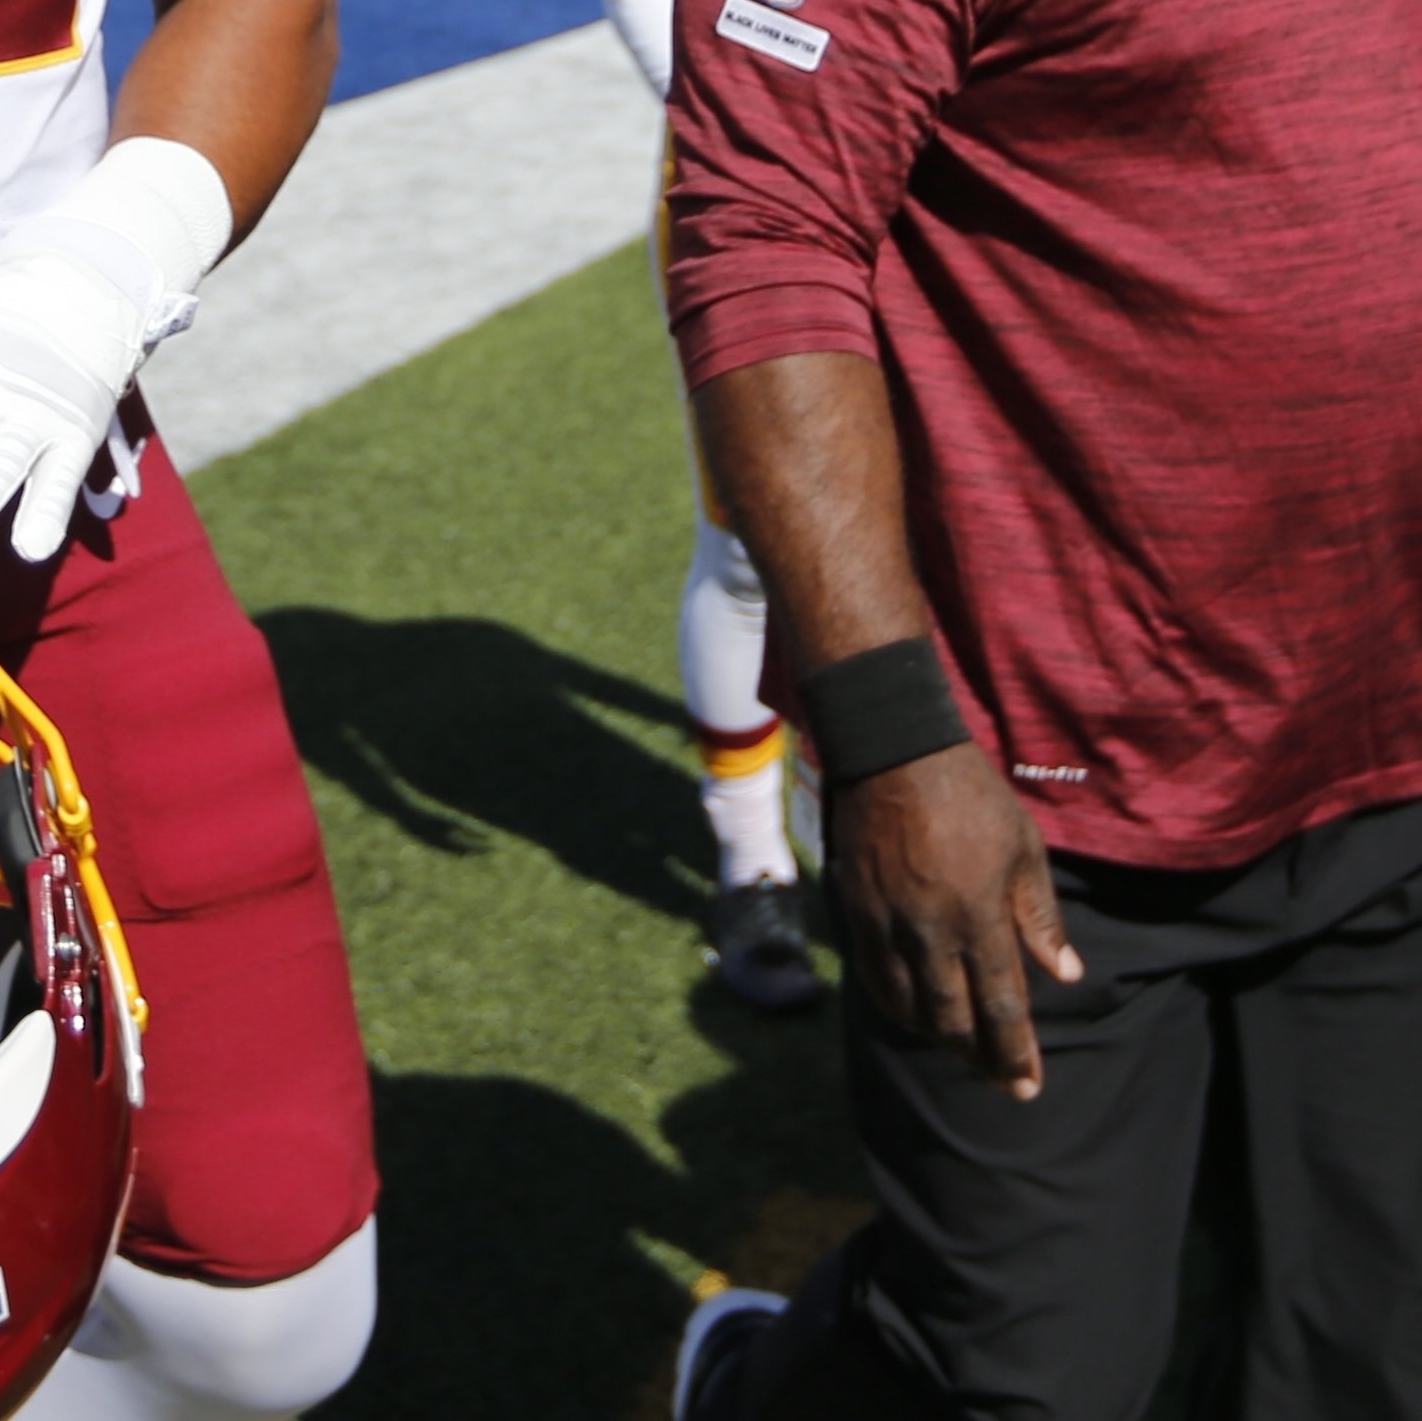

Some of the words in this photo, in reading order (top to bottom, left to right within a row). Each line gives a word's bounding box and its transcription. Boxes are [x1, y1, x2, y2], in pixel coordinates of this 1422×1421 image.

[725, 10, 755, 31] BLACK
[753, 20, 781, 41] LIVES
[782, 32, 818, 56] MATTER
